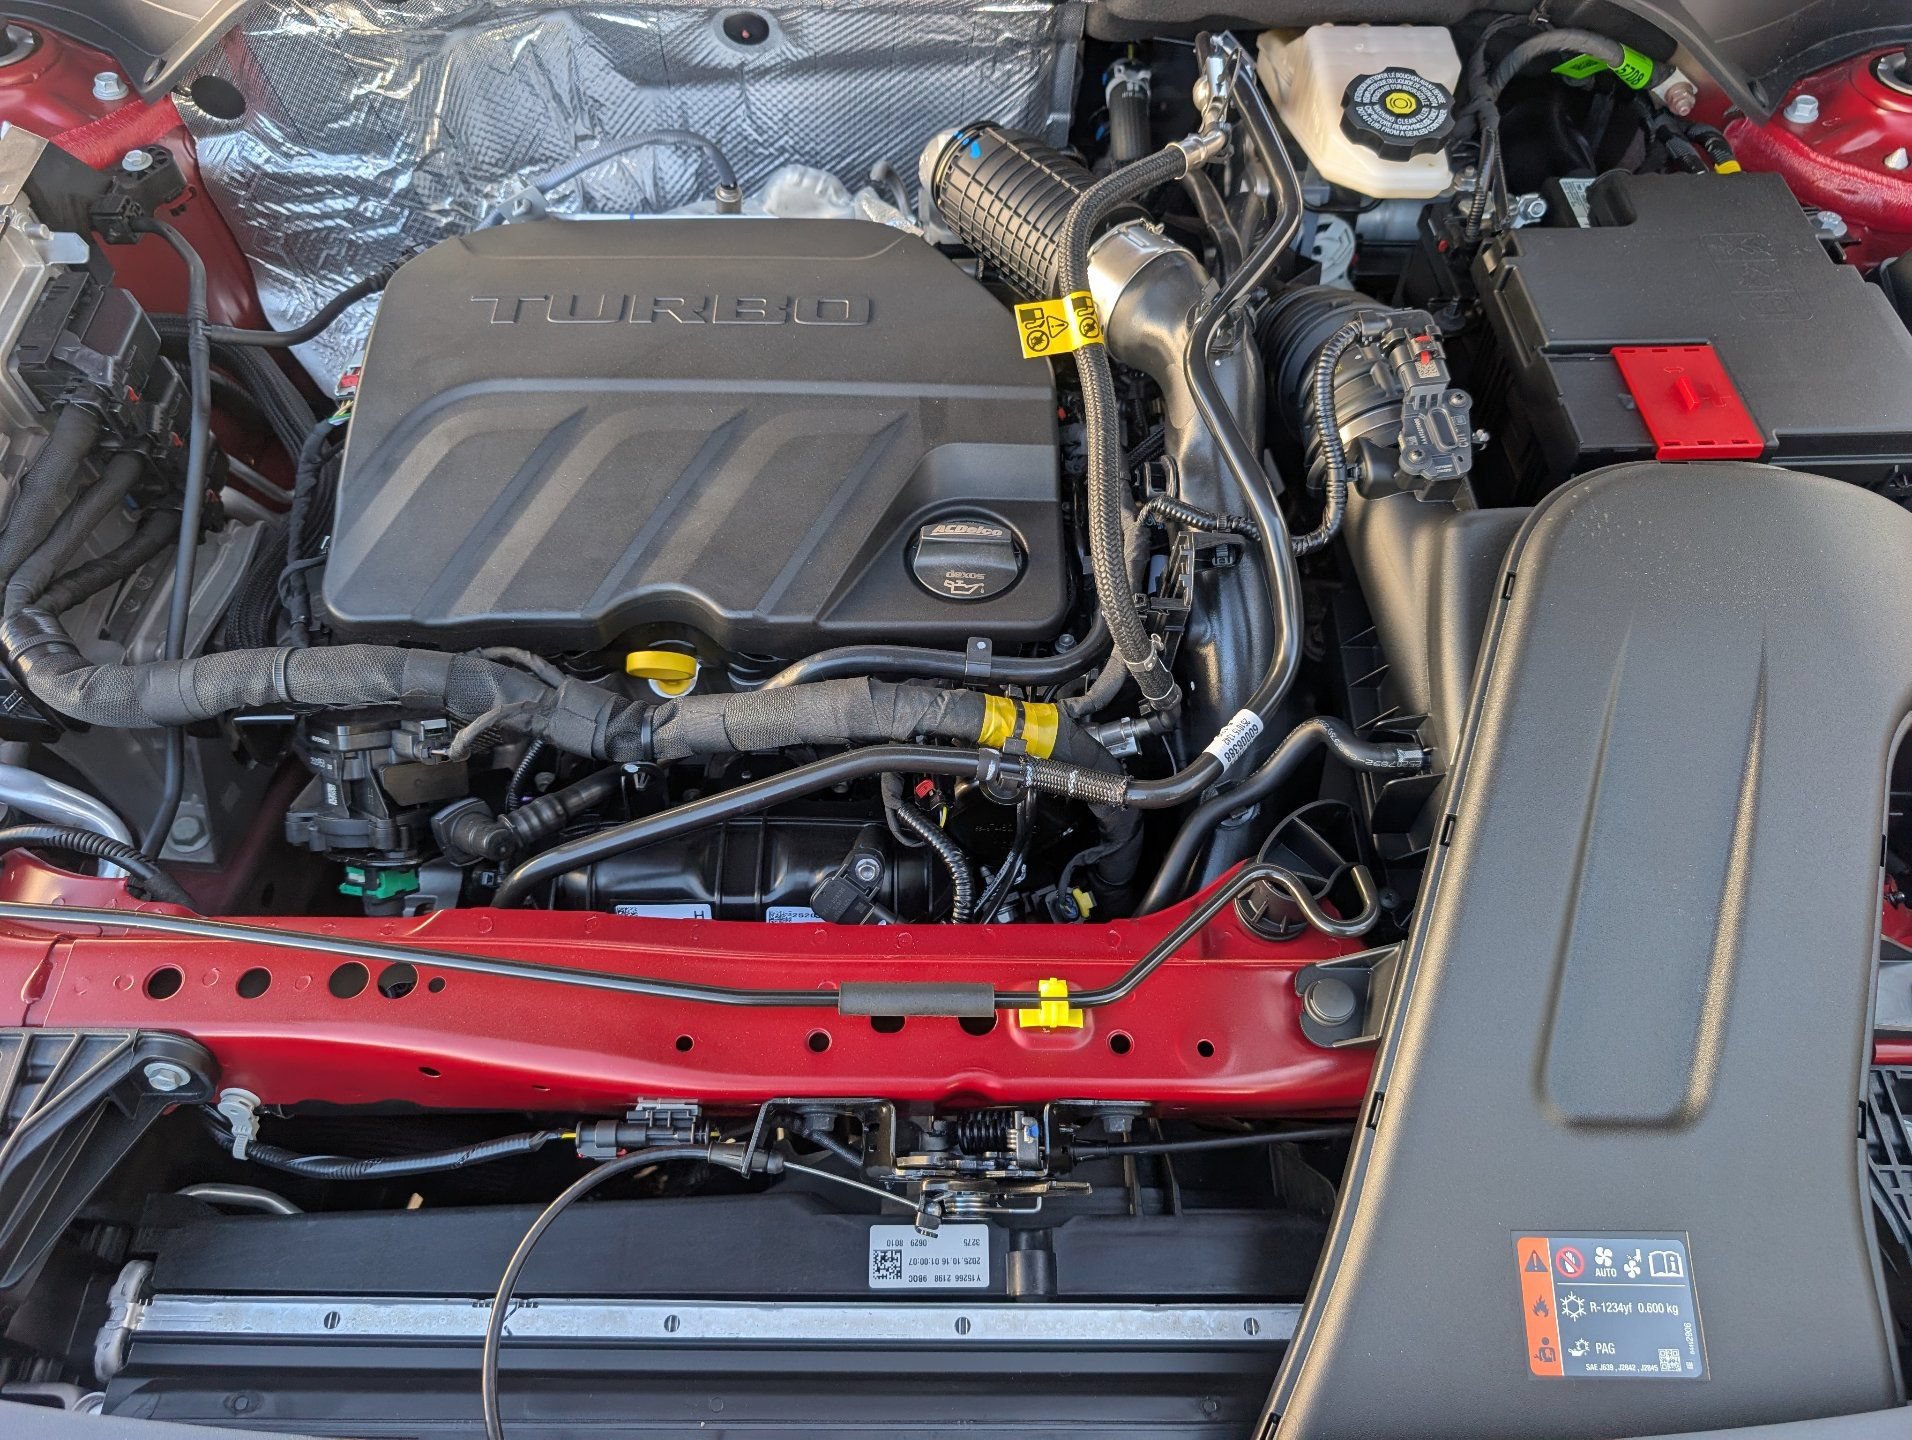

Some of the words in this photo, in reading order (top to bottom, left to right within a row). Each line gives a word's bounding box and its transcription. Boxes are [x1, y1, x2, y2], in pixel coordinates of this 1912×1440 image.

[1396, 73, 1420, 81] BOUCHON
[1366, 117, 1382, 129] FLUID
[1380, 127, 1399, 136] FROM
[1405, 128, 1428, 137] SEALED
[470, 294, 872, 326] TURBO
[930, 524, 1003, 538] ACDelco
[946, 570, 986, 580] dexos
[1224, 724, 1259, 762] 60008388
[908, 1258, 940, 1266] 01:00:07
[942, 1257, 981, 1265] 2025.10.16
[1595, 1268, 1617, 1278] AUTO
[1590, 1301, 1632, 1316] R-1234yf
[1638, 1302, 1664, 1314] 0.600
[1666, 1302, 1678, 1316] kg
[1595, 1342, 1616, 1354] PAG
